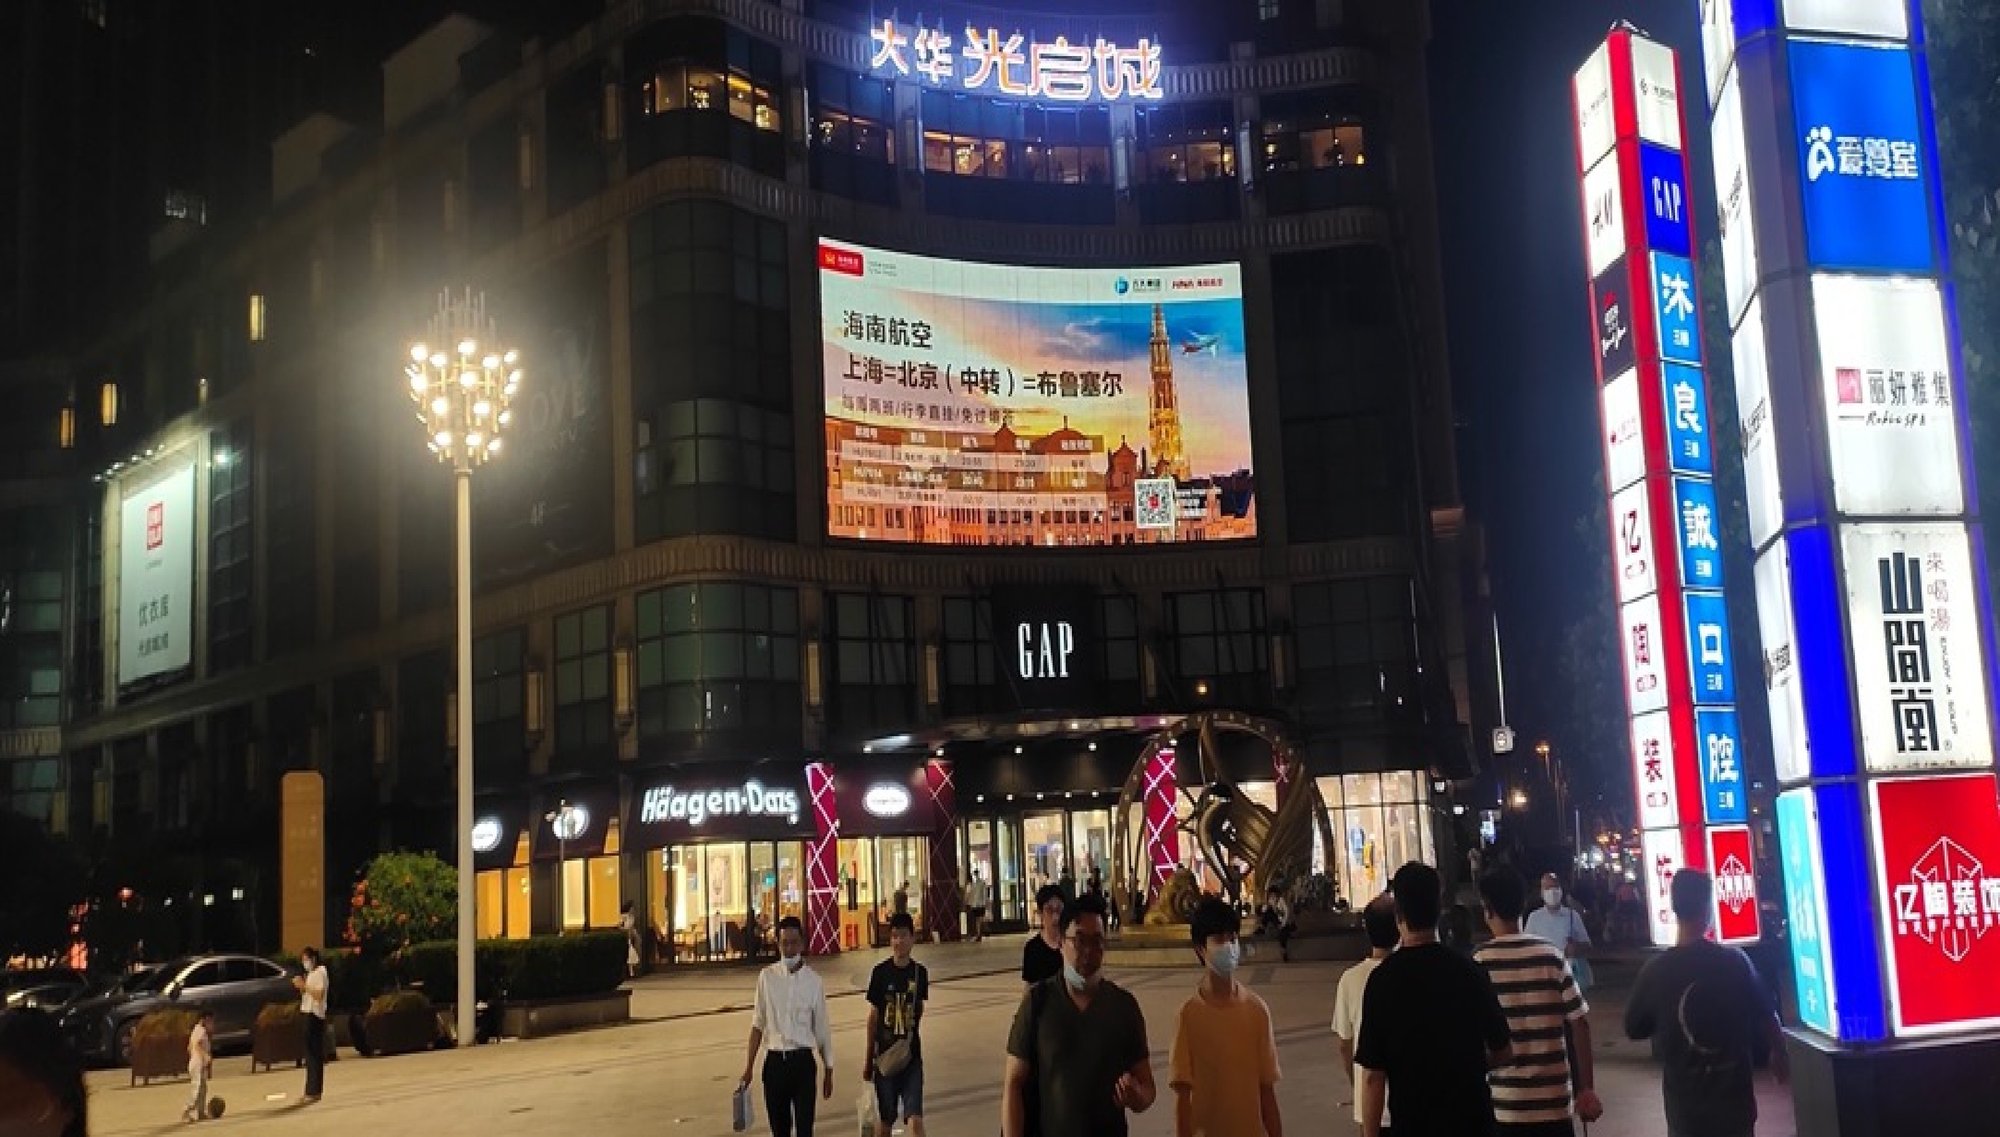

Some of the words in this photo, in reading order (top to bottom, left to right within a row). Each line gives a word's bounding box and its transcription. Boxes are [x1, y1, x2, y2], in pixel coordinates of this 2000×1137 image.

[1651, 176, 1681, 224] GAP
[843, 309, 933, 350] 海南航空
[1018, 621, 1073, 679] GAP
[1879, 552, 1940, 753] 山間堂
